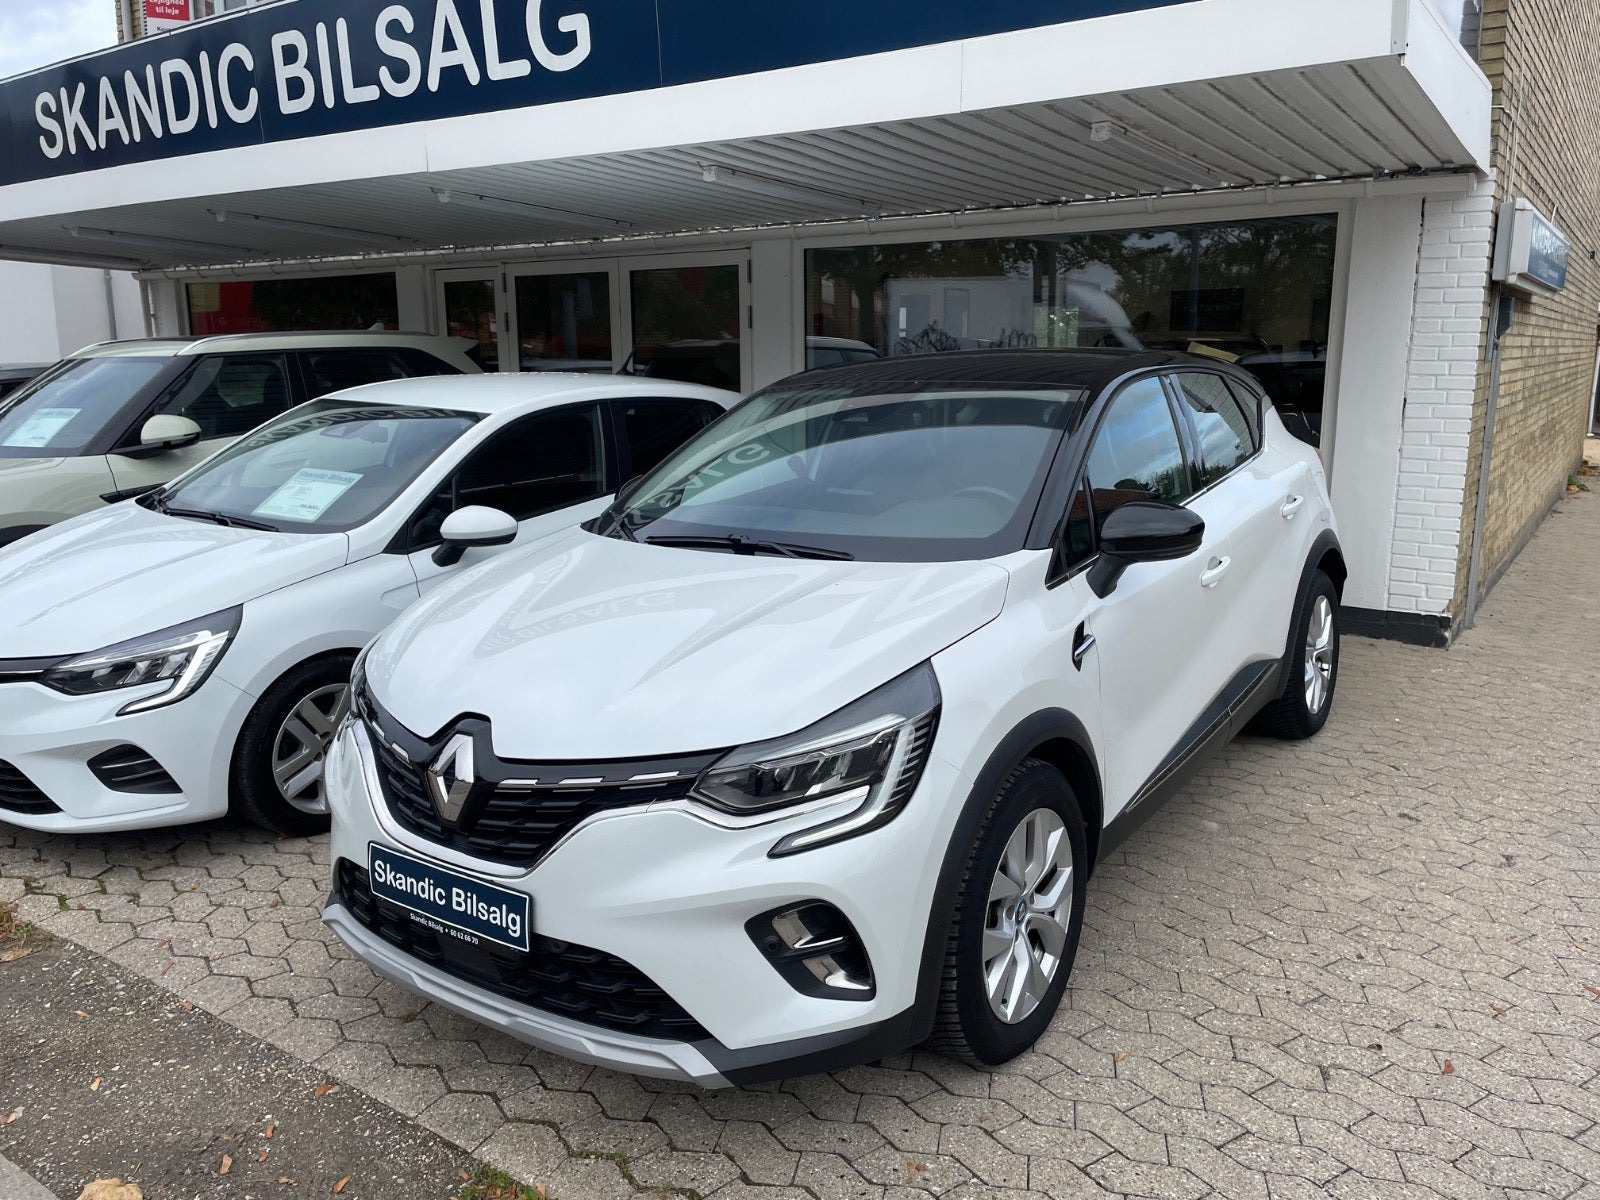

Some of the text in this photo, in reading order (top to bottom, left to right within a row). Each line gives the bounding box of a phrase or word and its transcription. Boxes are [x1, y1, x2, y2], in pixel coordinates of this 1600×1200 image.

[165, 6, 180, 15] leje
[35, 0, 591, 159] SKANDIC BILSALG
[374, 860, 521, 938] Skandic Bilsalg
[410, 912, 428, 926] Skandic
[428, 919, 443, 933] Bilsalg
[457, 931, 464, 940] 62
[471, 936, 479, 945] 70
